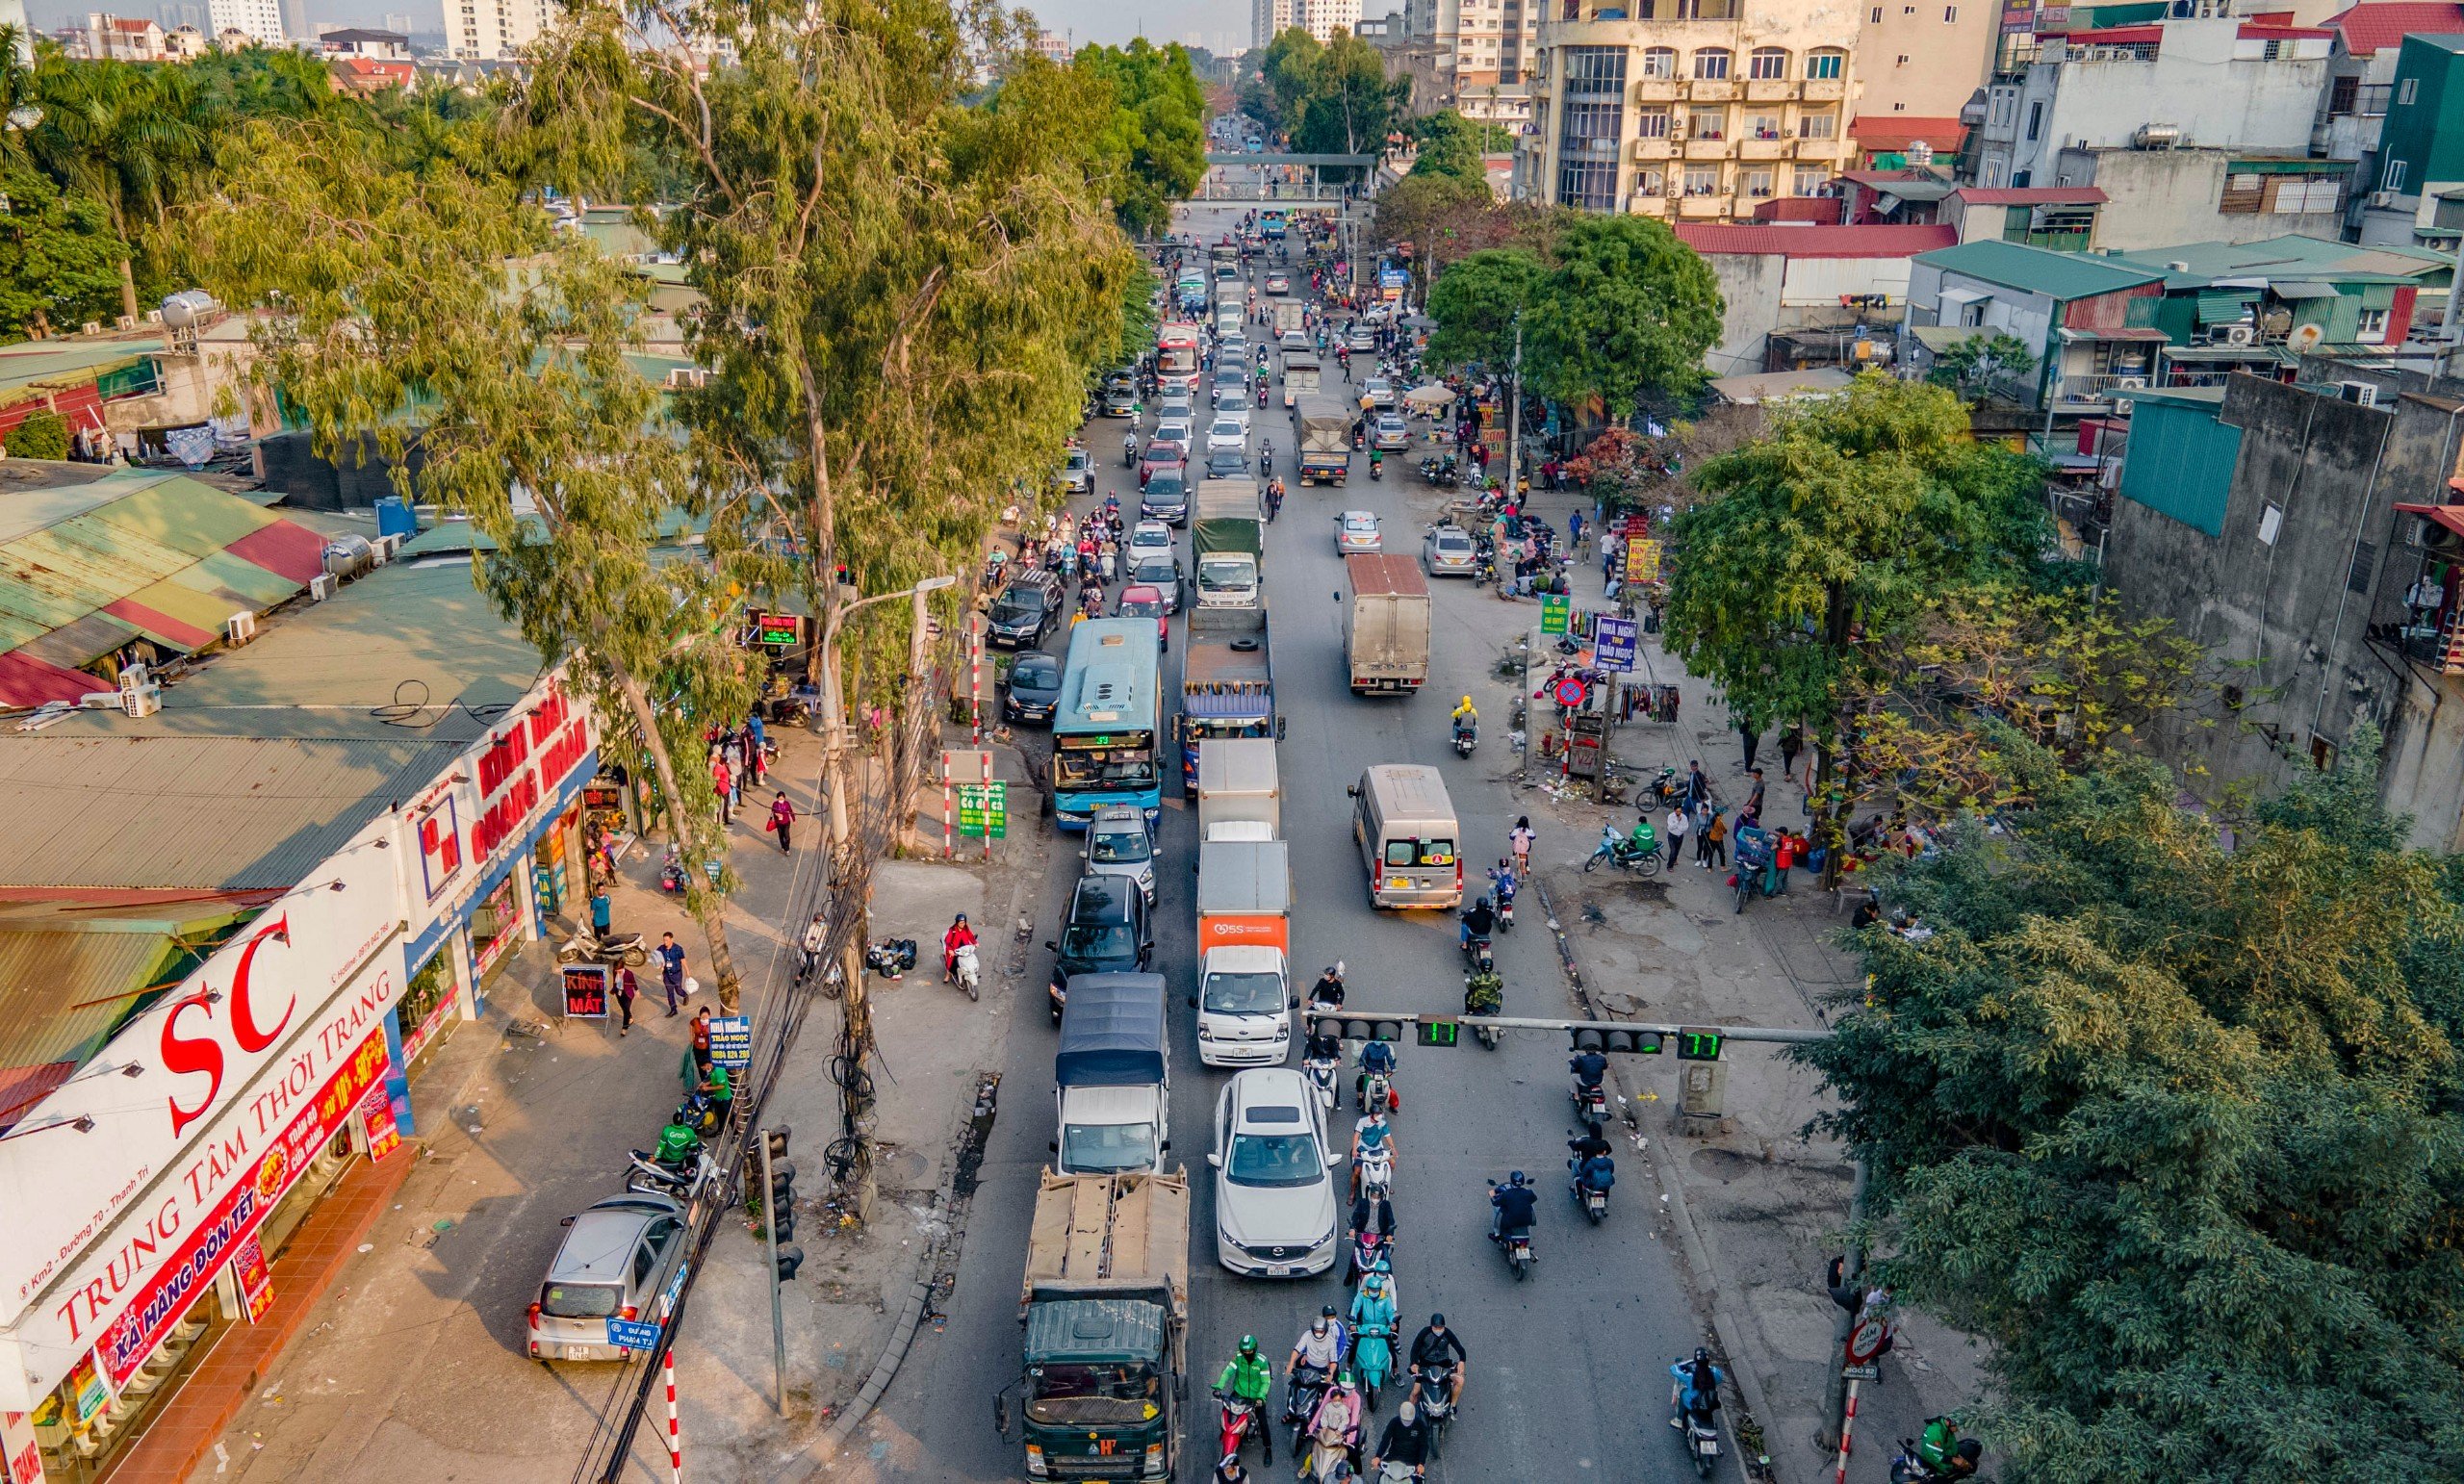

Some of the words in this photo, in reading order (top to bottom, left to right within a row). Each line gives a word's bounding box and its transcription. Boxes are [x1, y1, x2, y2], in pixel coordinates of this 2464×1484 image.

[1601, 623, 1616, 636] NHÀ
[477, 720, 528, 801] KÍNH
[472, 768, 539, 865] QUANG
[539, 715, 588, 795] NHÂN
[566, 971, 604, 991] KÍNH
[570, 992, 603, 1014] MẮT
[1686, 1032, 1718, 1056] 77
[57, 1196, 181, 1345] TRUNG
[183, 1130, 249, 1208] TÂM
[249, 1050, 317, 1138] THỜI
[318, 970, 390, 1064] TRANG
[289, 1116, 308, 1147] TOÀN
[31, 1262, 53, 1289] Km2
[110, 1178, 137, 1206] Thanh
[143, 1263, 192, 1336] HÀNG
[192, 1221, 230, 1272] ĐÓN
[230, 1184, 256, 1229] TẾT
